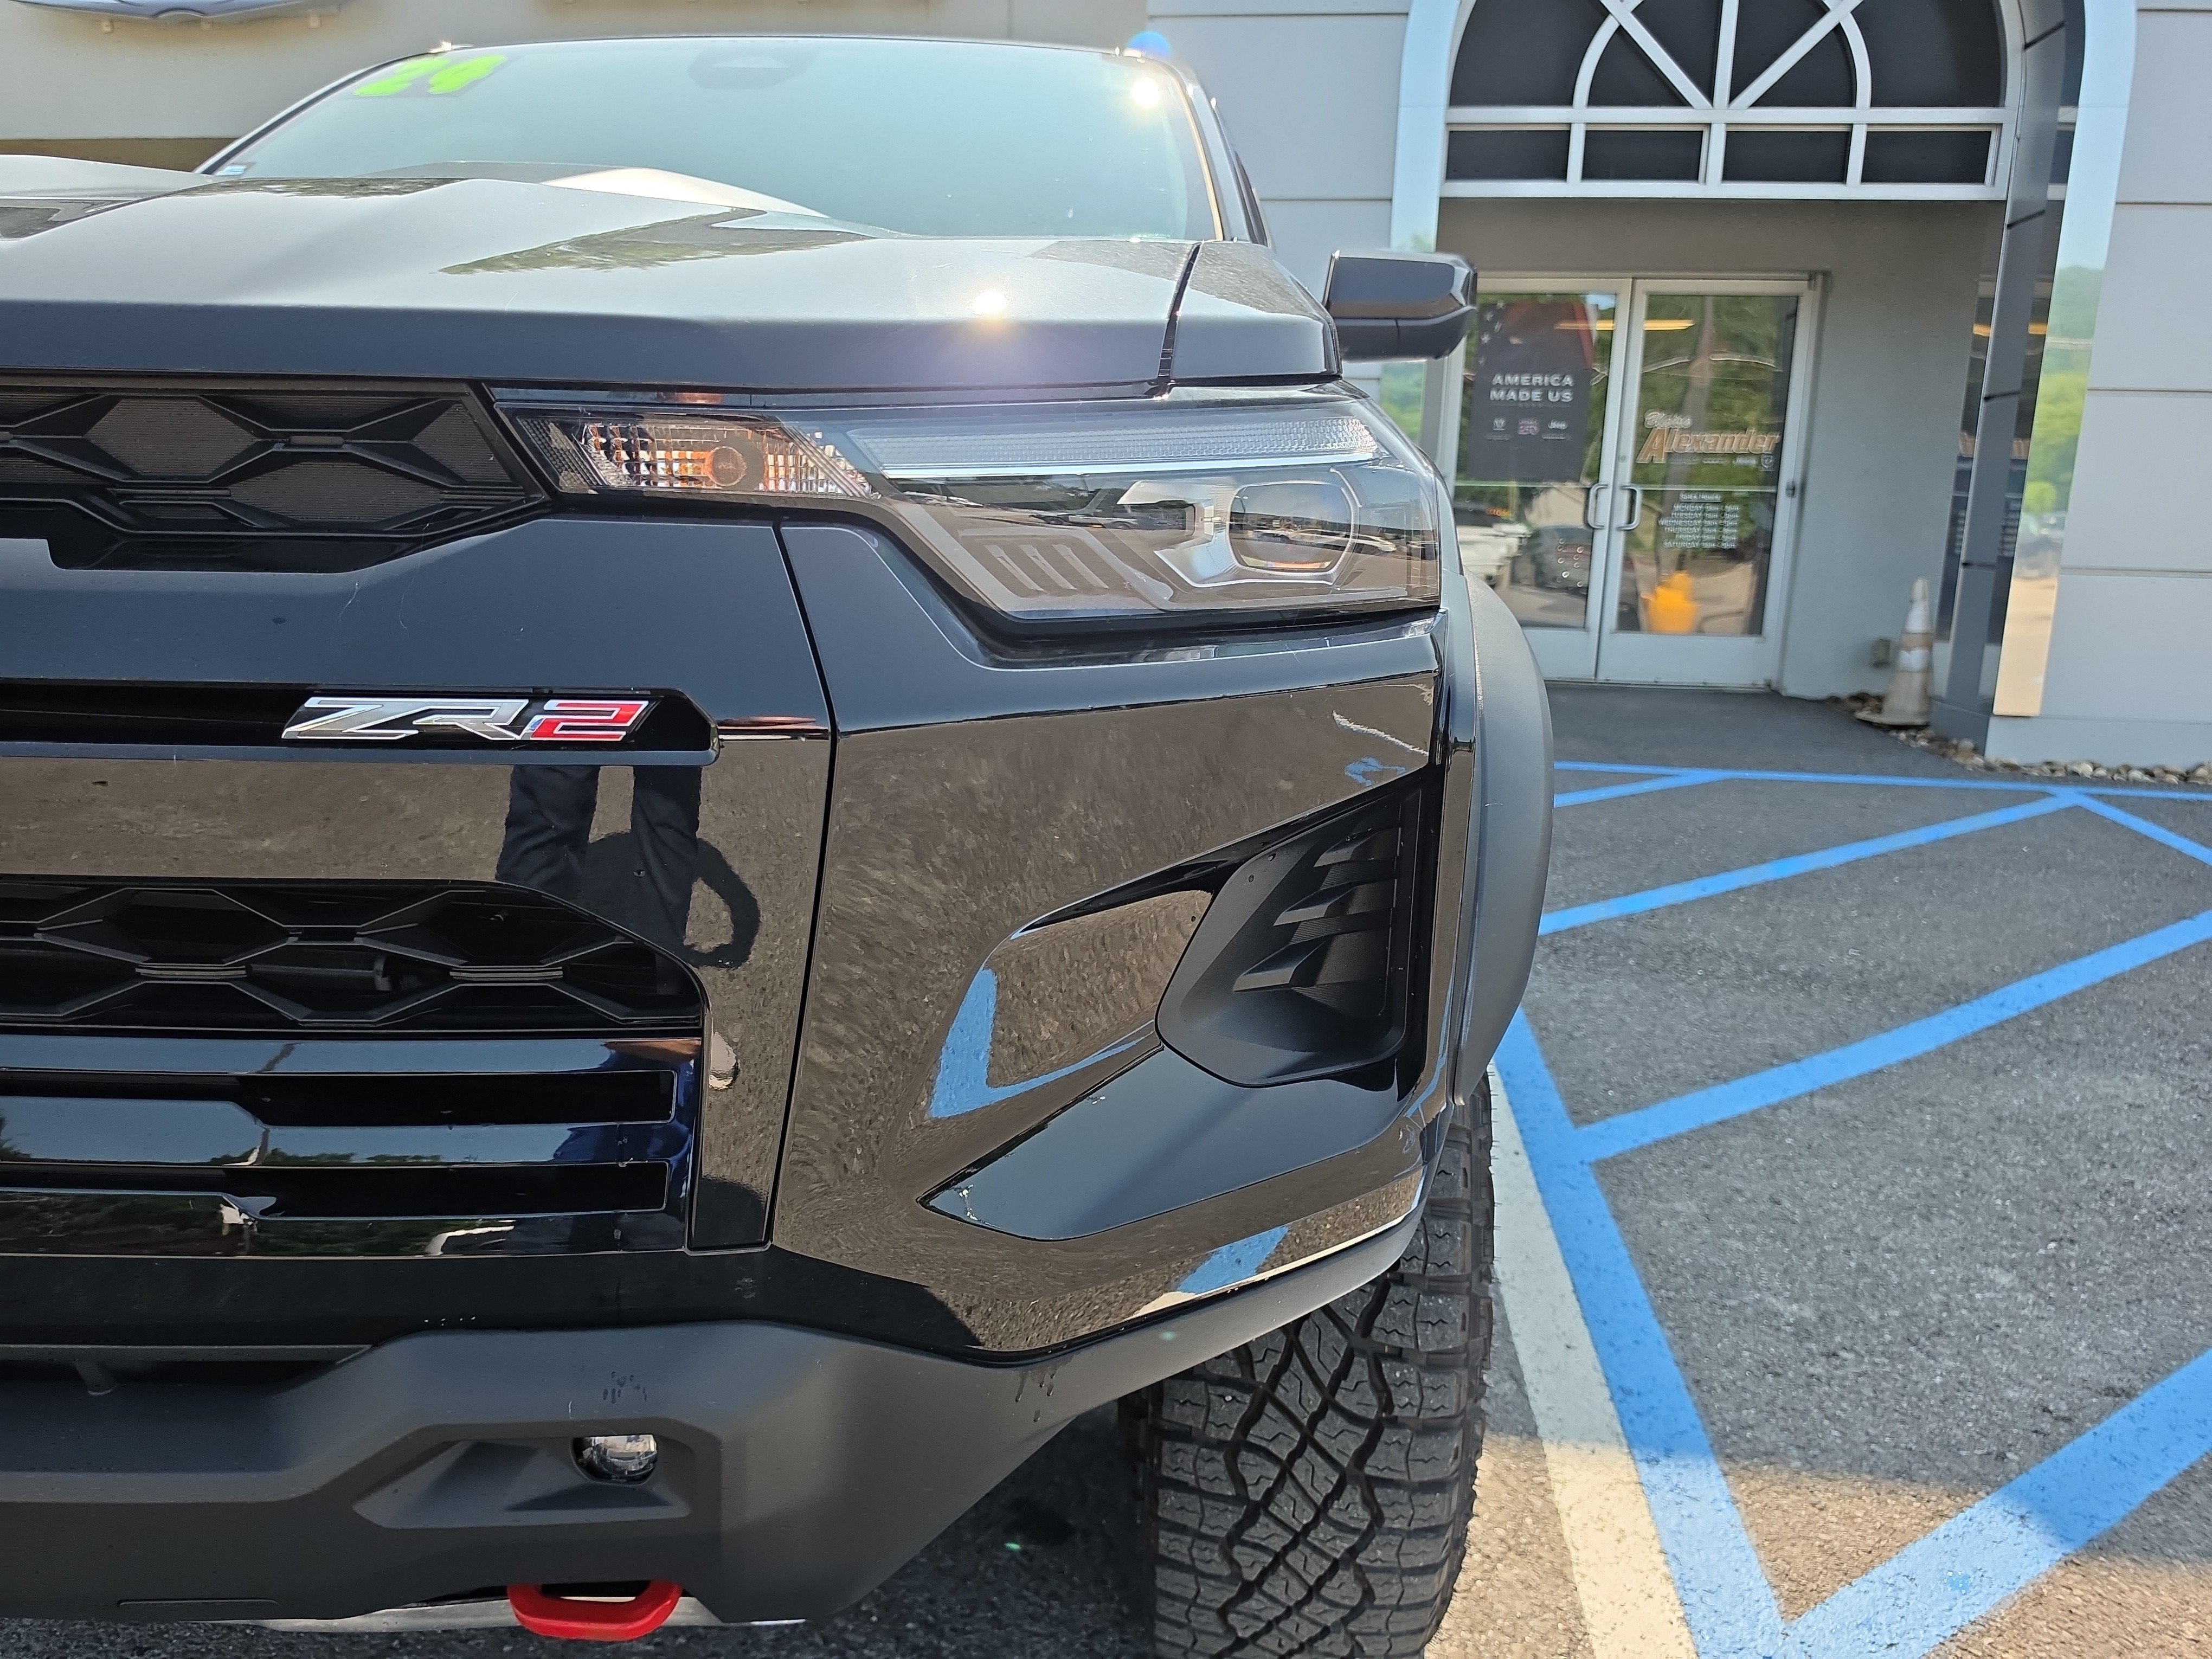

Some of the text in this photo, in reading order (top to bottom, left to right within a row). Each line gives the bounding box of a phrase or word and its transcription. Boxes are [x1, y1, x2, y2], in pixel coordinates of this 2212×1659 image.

[1492, 374, 1573, 387] AMERICA
[1490, 389, 1573, 402] MADE US
[1636, 428, 1780, 464] Alexander
[280, 696, 650, 741] ZR2
